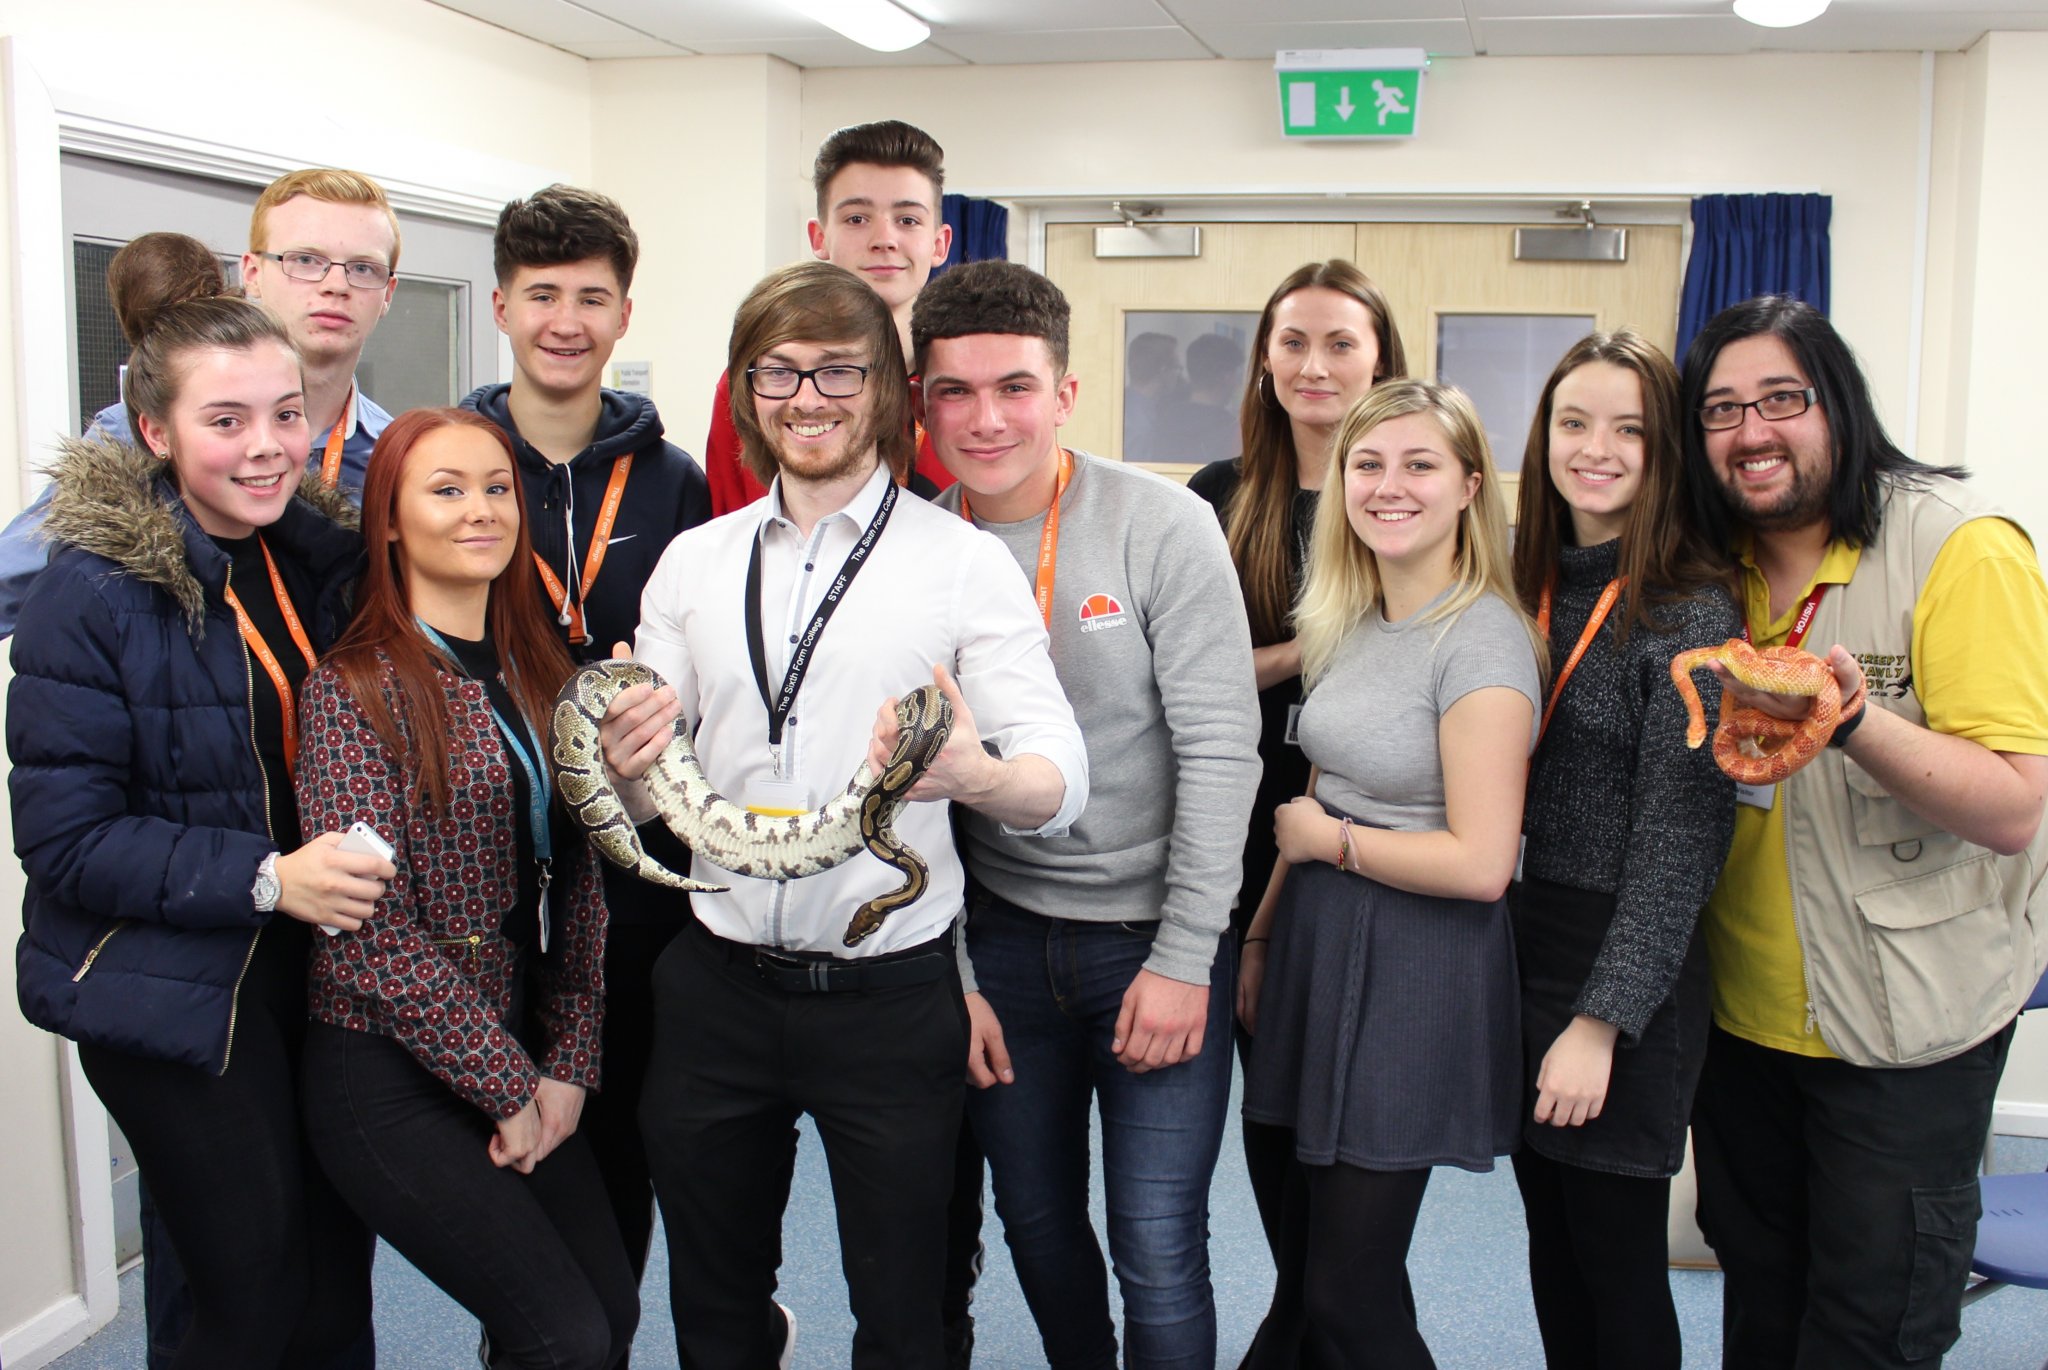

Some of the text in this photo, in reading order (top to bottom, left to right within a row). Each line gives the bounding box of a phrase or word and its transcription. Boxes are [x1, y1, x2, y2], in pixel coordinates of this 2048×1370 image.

[610, 487, 620, 500] The
[605, 500, 617, 519] Sixth
[1046, 509, 1055, 530] Form
[600, 519, 611, 536] Form
[851, 488, 896, 562] The Sixth Form College
[1044, 531, 1052, 550] Sixth
[1042, 551, 1050, 568] The
[550, 582, 562, 600] Sixth
[828, 574, 847, 602] STAFF
[281, 597, 292, 615] Sixth
[1592, 590, 1613, 624] The Sixth
[291, 616, 299, 630] The
[1080, 617, 1127, 633] ellesse
[1794, 602, 1816, 635] VISITOR
[778, 617, 823, 712] The Sixth Form College
[1564, 640, 1585, 673] STUDENT
[1857, 653, 1906, 666] CREEPY
[261, 649, 272, 664] The
[271, 664, 284, 685] Sixth
[281, 687, 290, 708] Form
[522, 758, 540, 806] STUDENT
[534, 808, 544, 844] College
